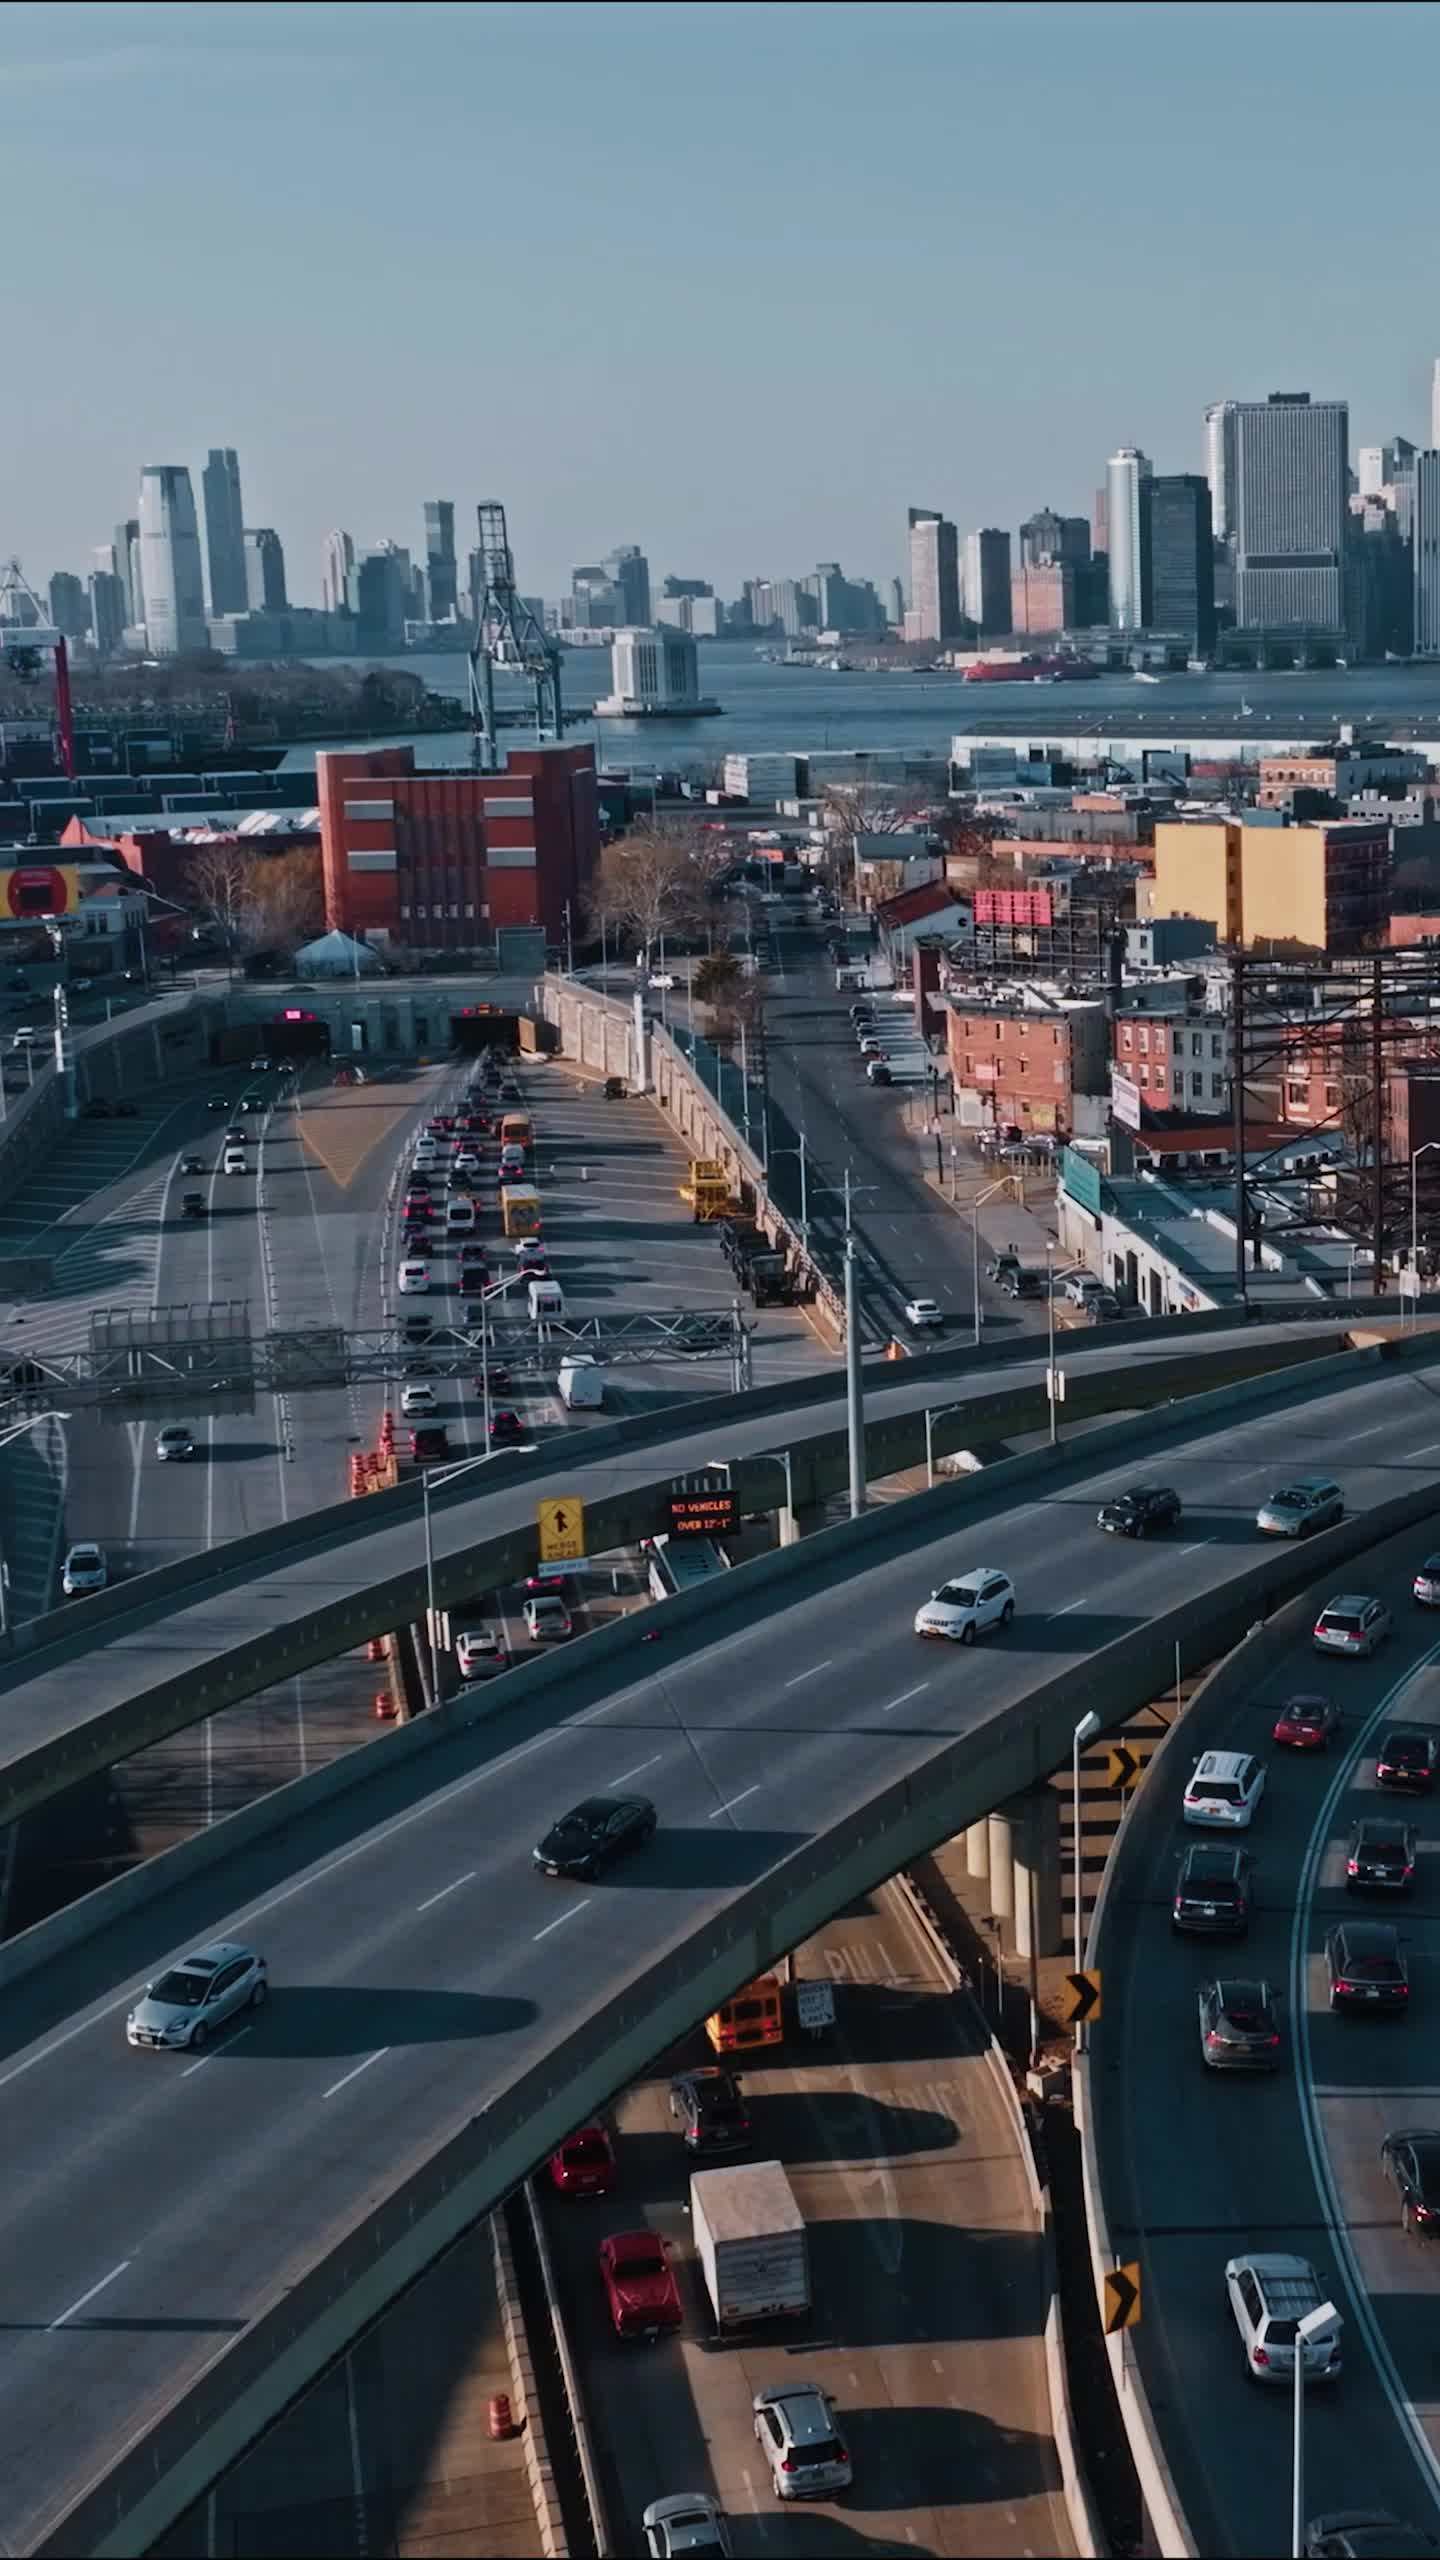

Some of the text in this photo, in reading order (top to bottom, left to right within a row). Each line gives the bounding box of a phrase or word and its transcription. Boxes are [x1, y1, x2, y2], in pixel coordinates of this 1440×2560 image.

[672, 1500, 732, 1513] NO VEHICLES
[677, 1520, 702, 1531] OVER
